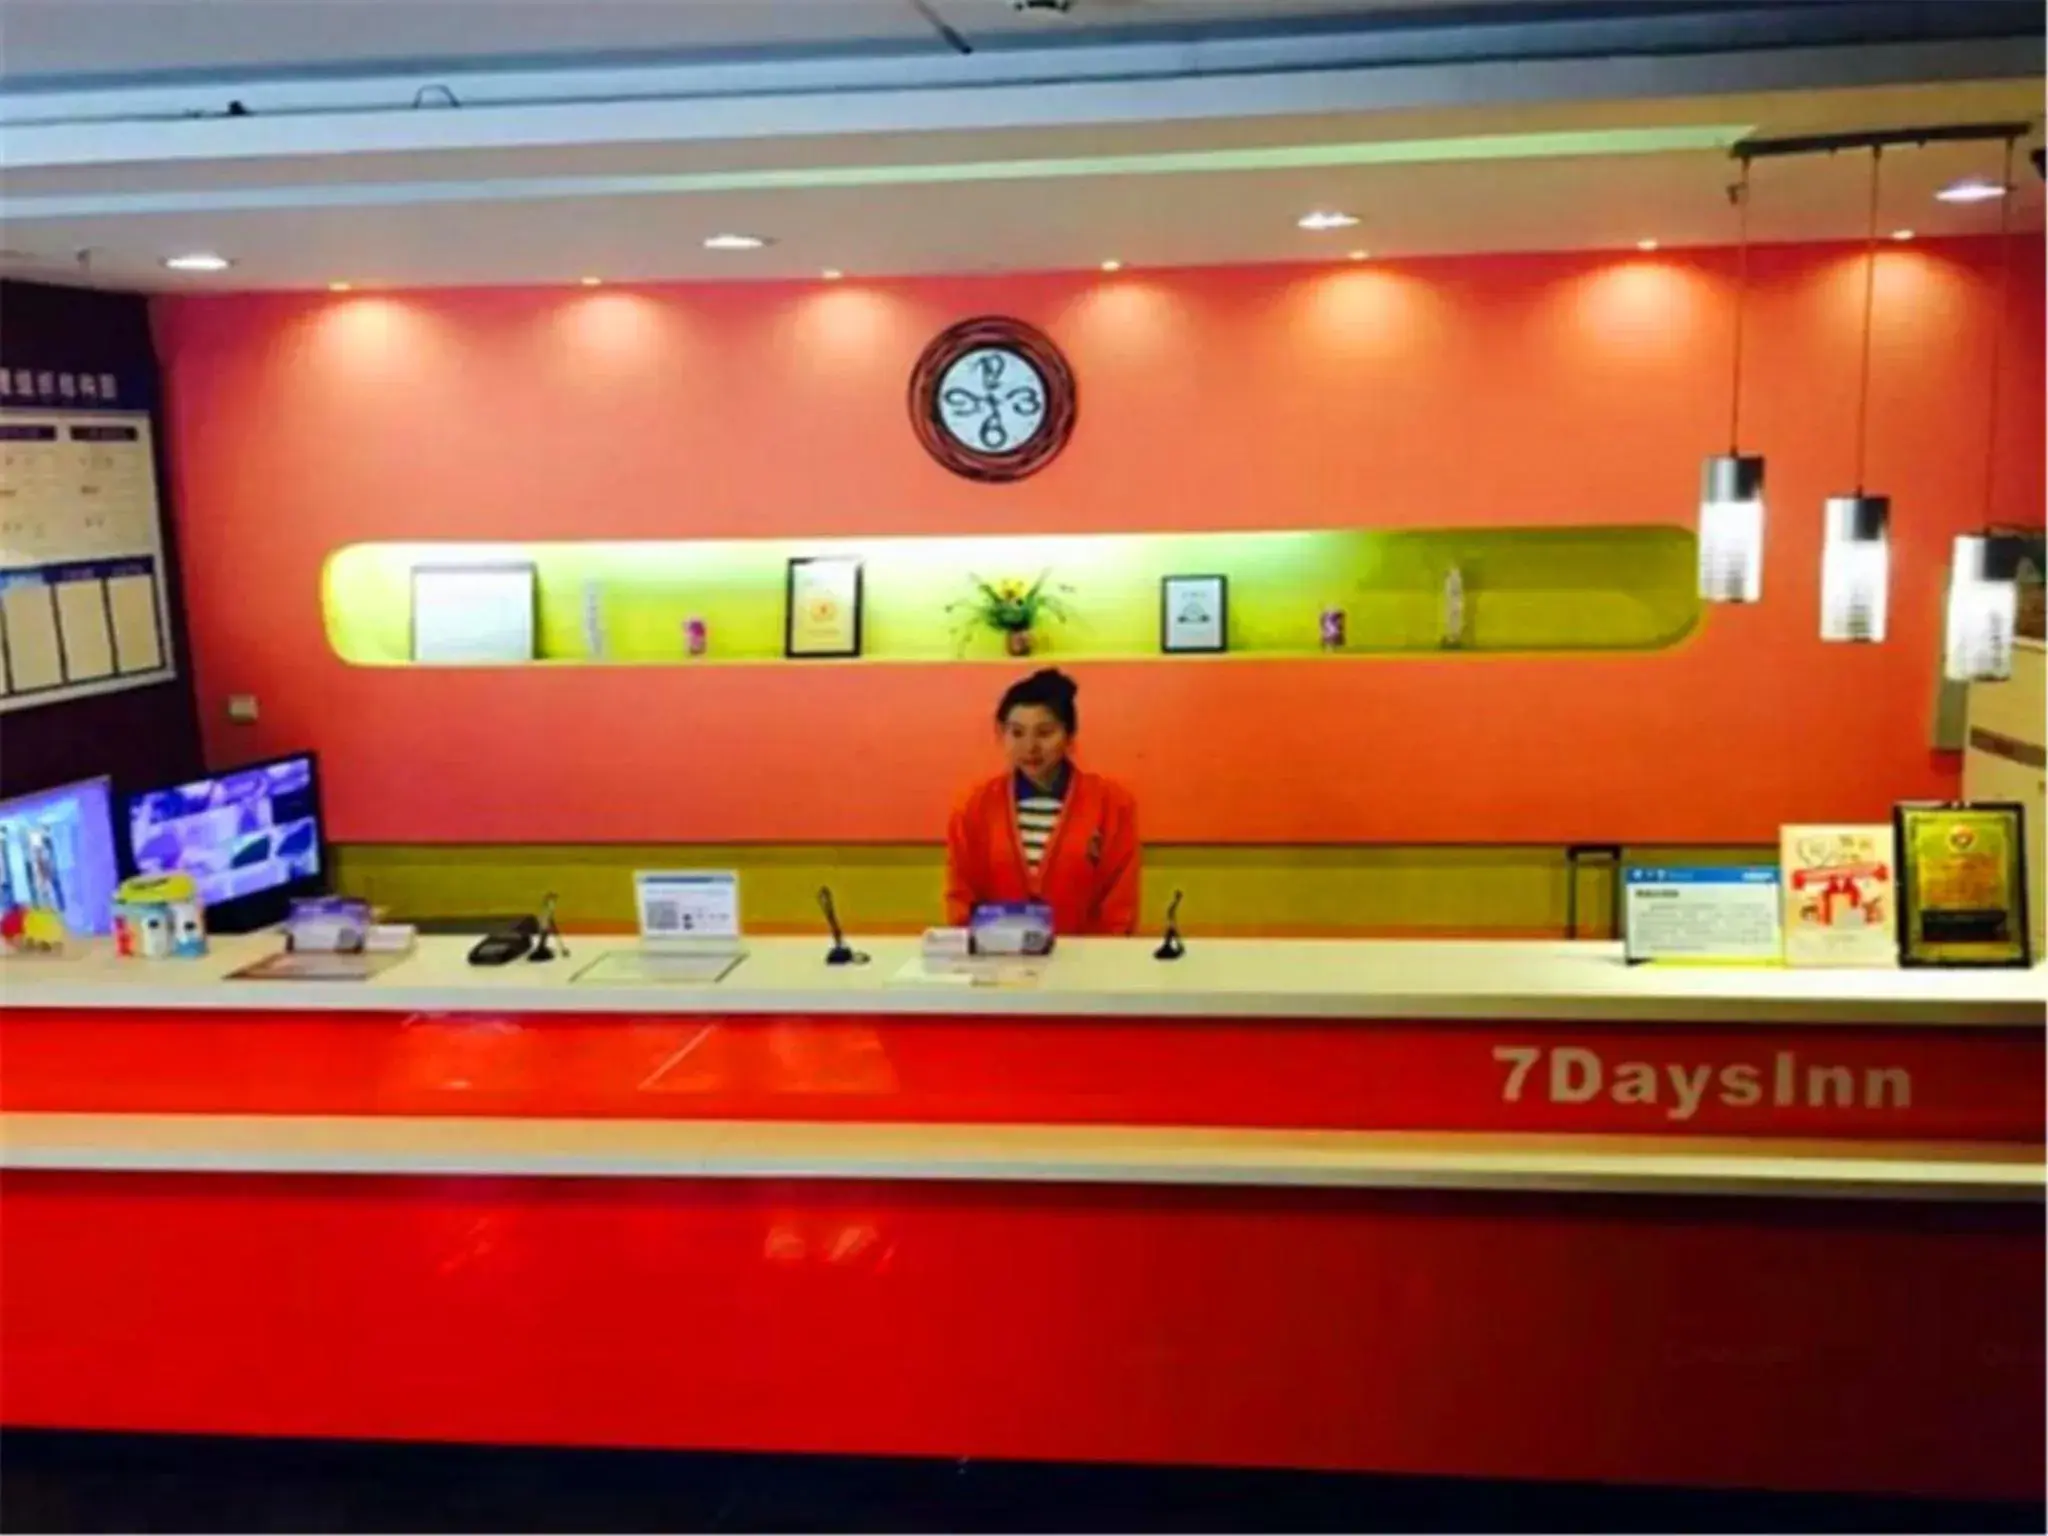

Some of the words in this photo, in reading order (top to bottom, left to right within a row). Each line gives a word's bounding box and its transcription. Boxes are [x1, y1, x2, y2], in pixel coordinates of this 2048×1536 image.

[944, 388, 982, 417] 9
[1006, 386, 1041, 416] 3
[980, 412, 1008, 449] 6
